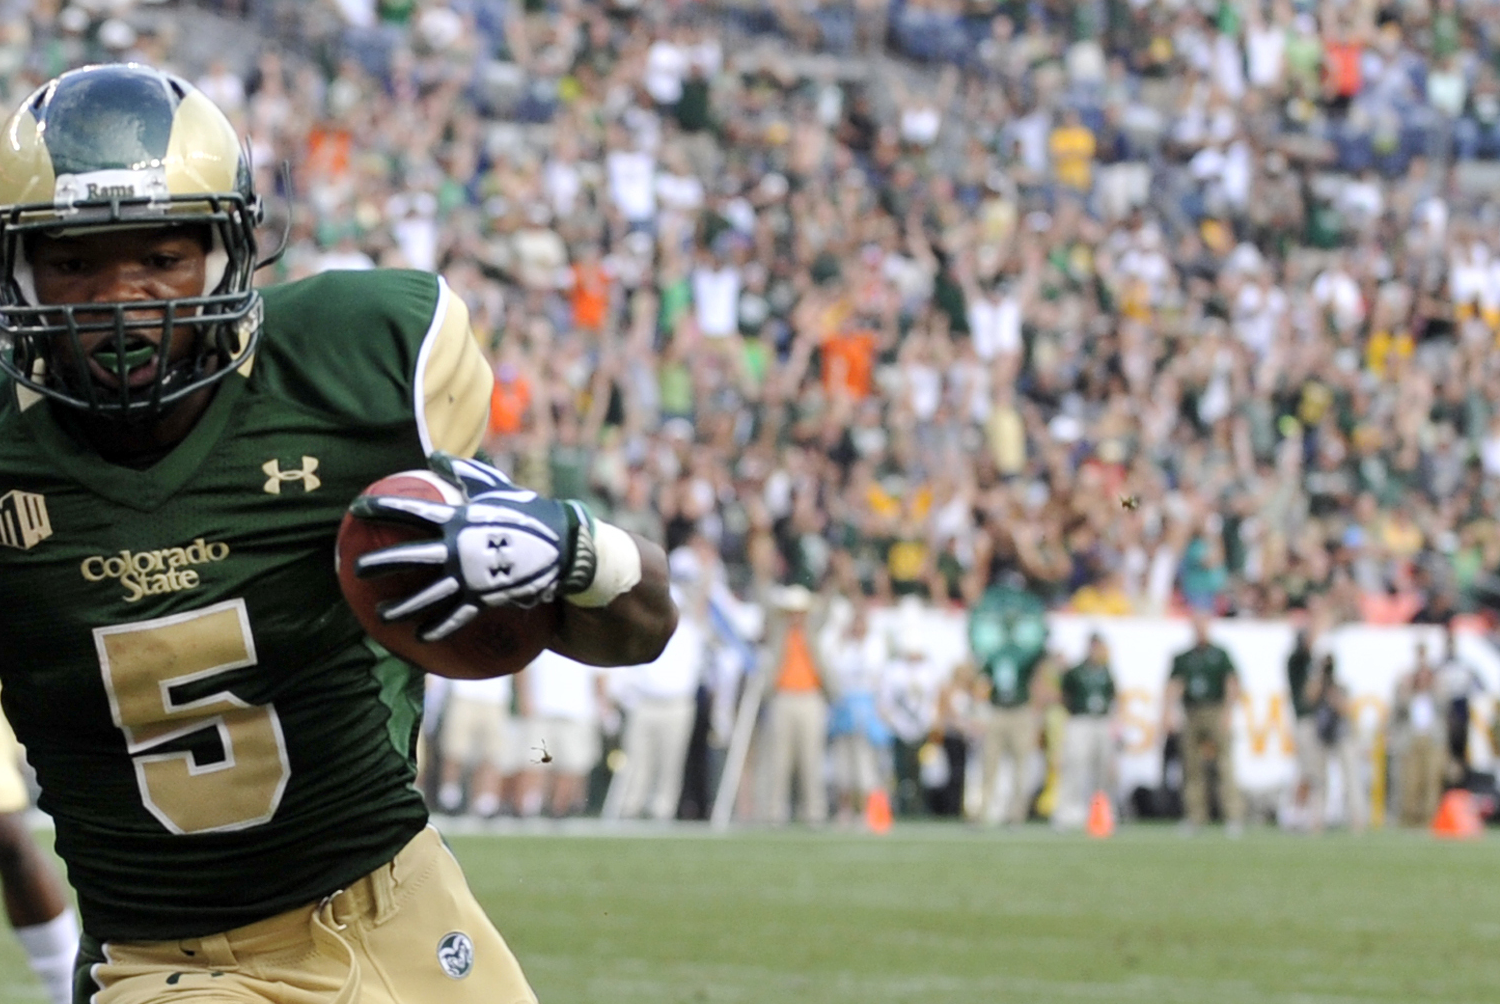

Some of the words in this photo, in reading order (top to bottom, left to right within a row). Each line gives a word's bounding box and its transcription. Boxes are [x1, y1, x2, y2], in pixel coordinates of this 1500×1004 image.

[85, 182, 135, 200] Rams
[80, 538, 230, 582] Colorado
[120, 567, 200, 602] State
[92, 598, 291, 835] 5
